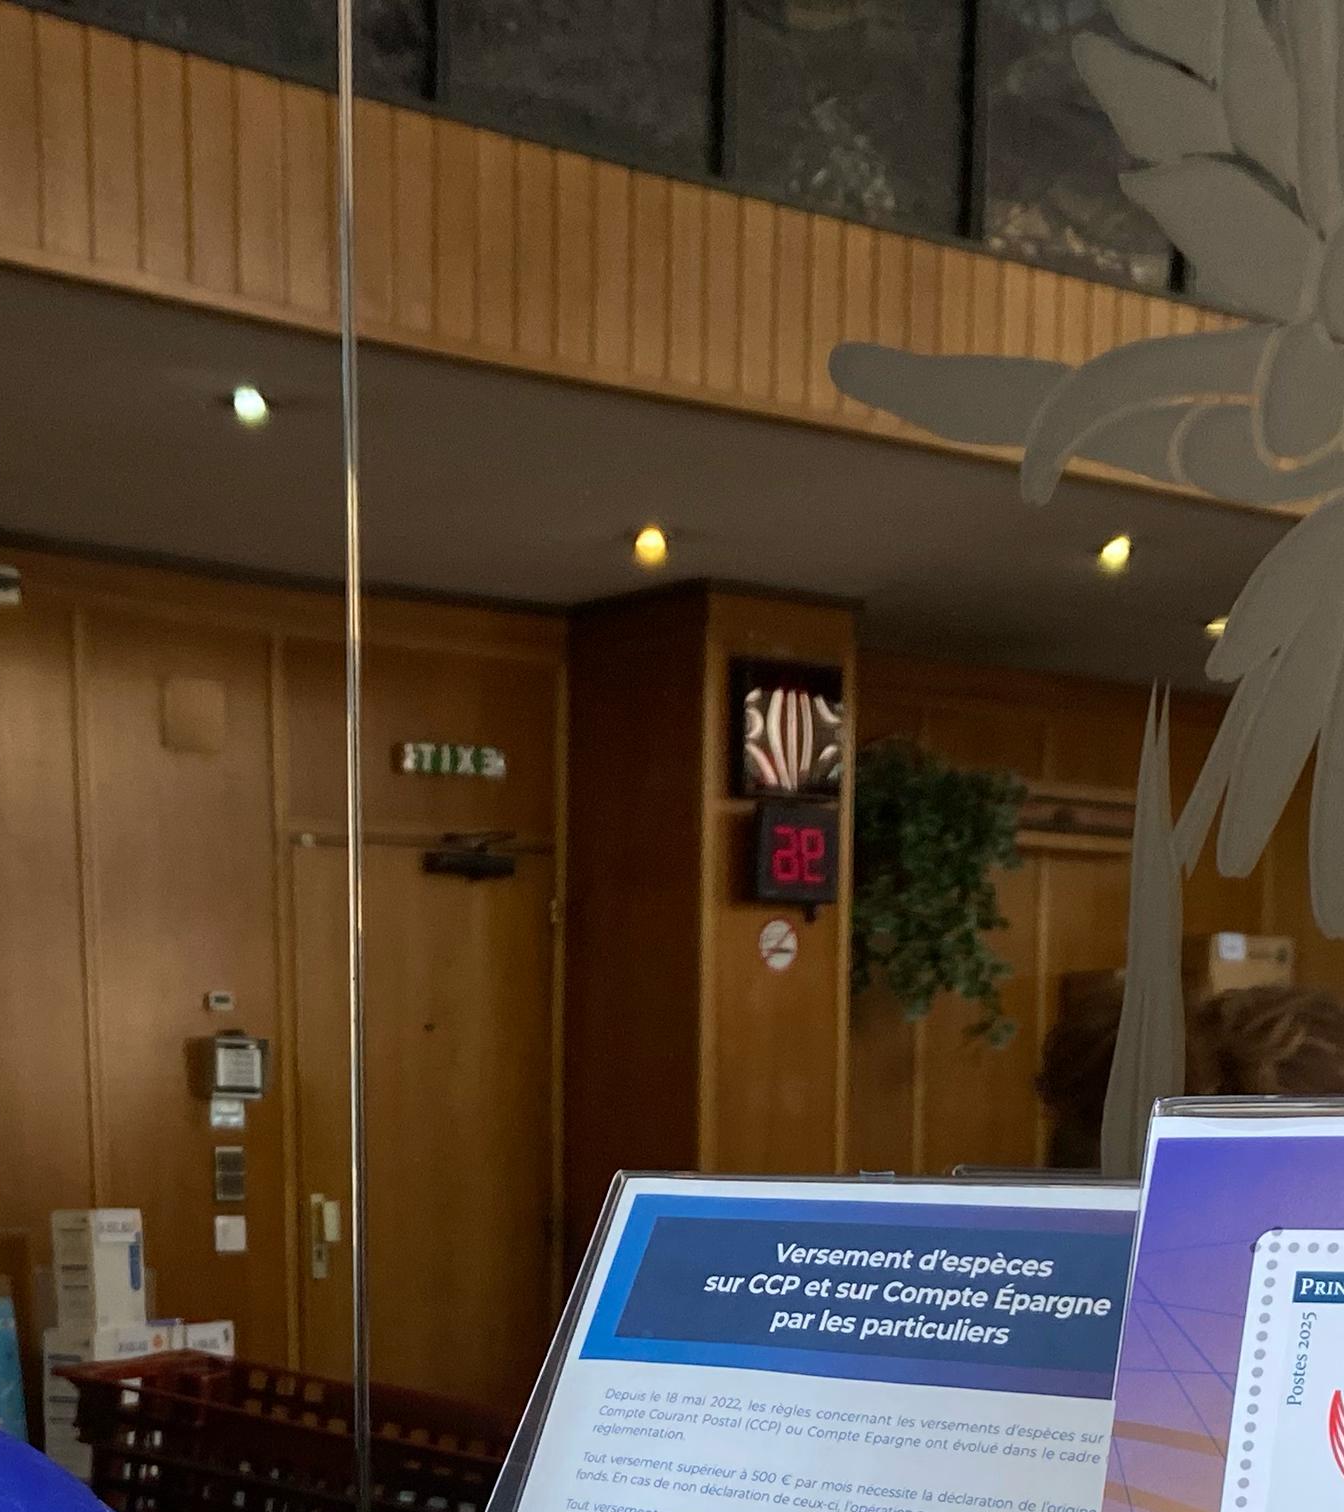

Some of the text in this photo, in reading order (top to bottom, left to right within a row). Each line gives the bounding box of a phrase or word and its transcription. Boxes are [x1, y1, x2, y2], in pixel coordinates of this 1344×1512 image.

[776, 1243, 1054, 1278] Versement d'espèces
[704, 1275, 1111, 1319] sur CCP et sur Compte Épargne
[769, 1310, 1009, 1345] par les particuliers
[1287, 1312, 1317, 1405] Postes 2025
[606, 1388, 1104, 1444] Depuis le 18 mai 2022, les règles concernant les versements d'espèces sur
